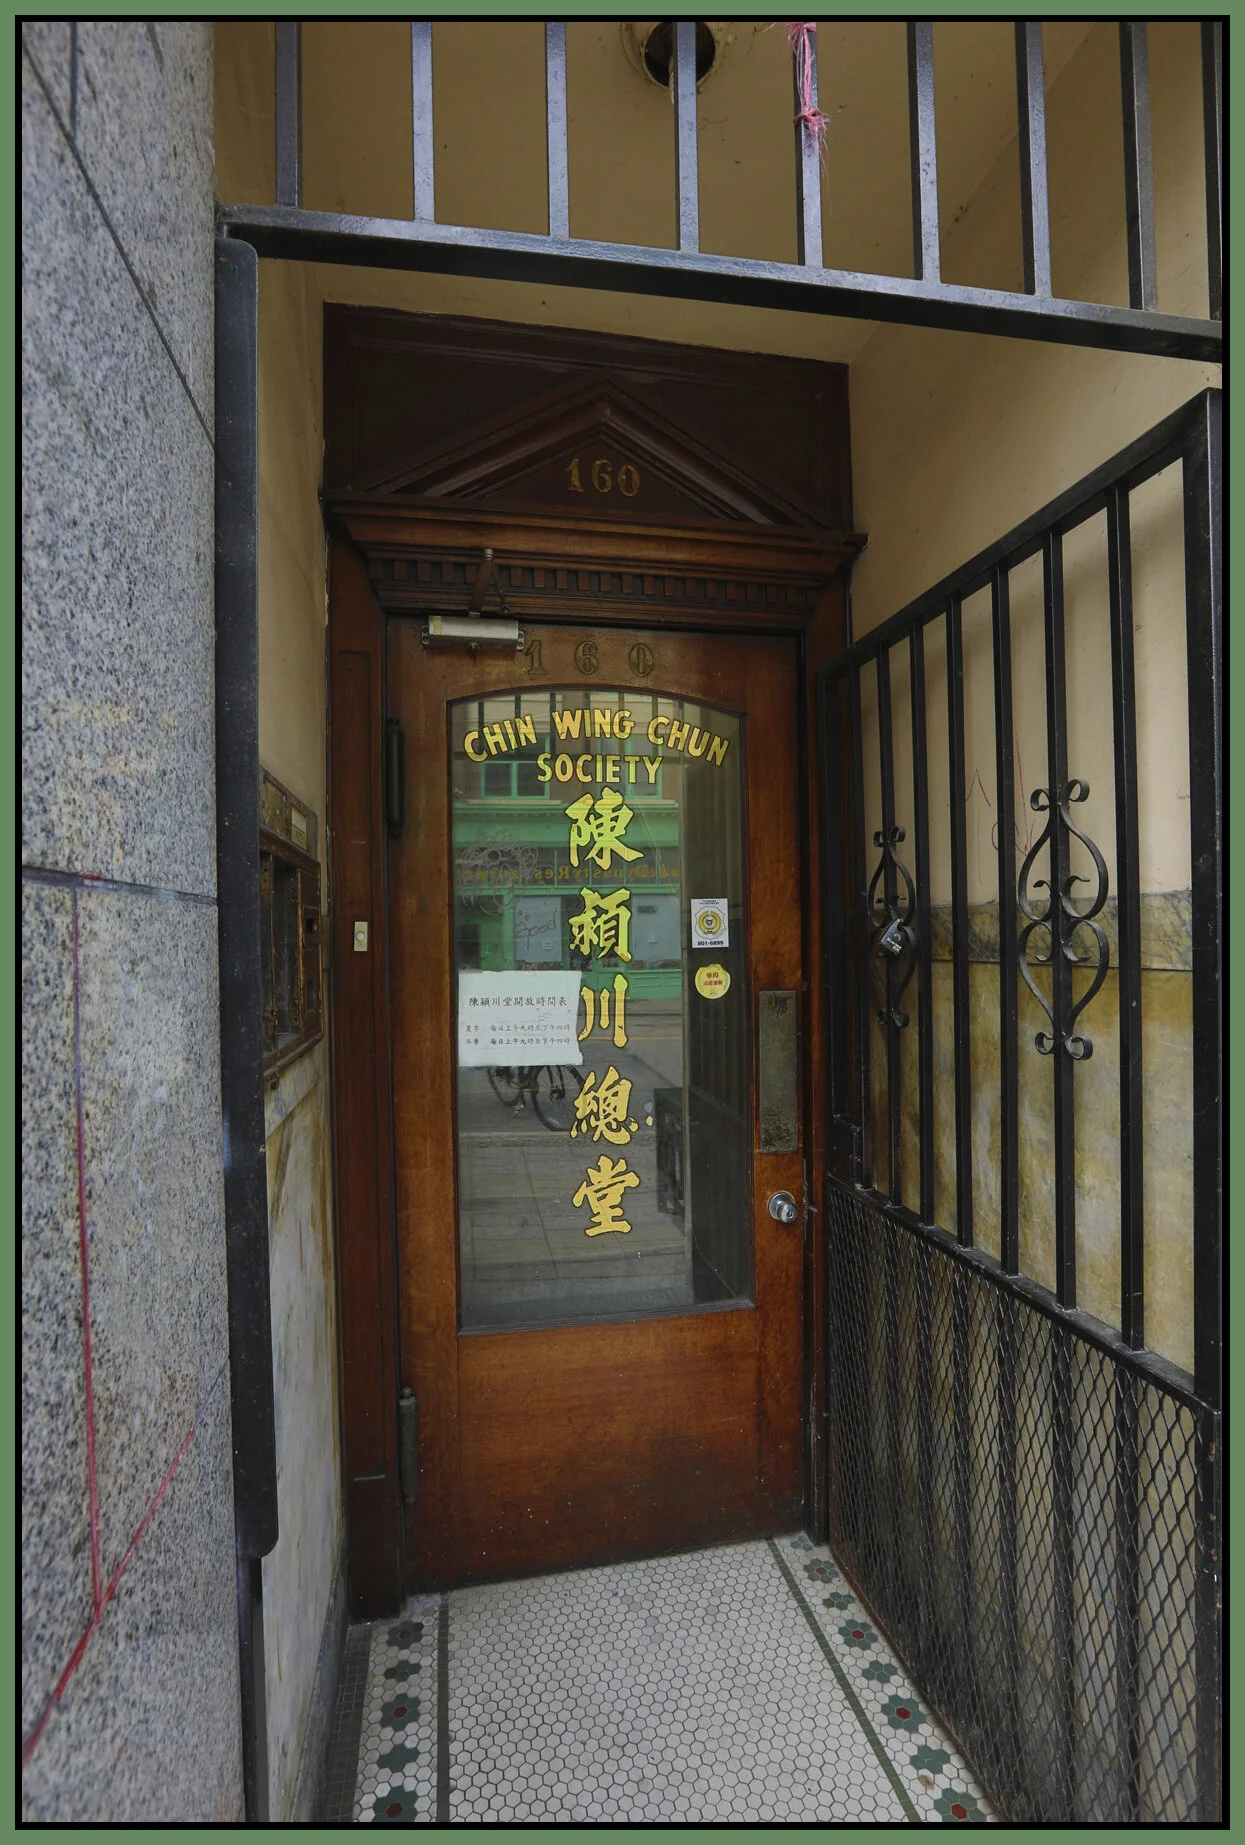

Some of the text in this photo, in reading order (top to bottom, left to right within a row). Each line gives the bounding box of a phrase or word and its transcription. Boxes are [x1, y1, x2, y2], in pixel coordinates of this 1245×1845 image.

[565, 458, 640, 497] 160
[524, 639, 654, 677] 160
[464, 709, 731, 767] CHIN WING CHUN
[536, 753, 664, 784] SOCIETY
